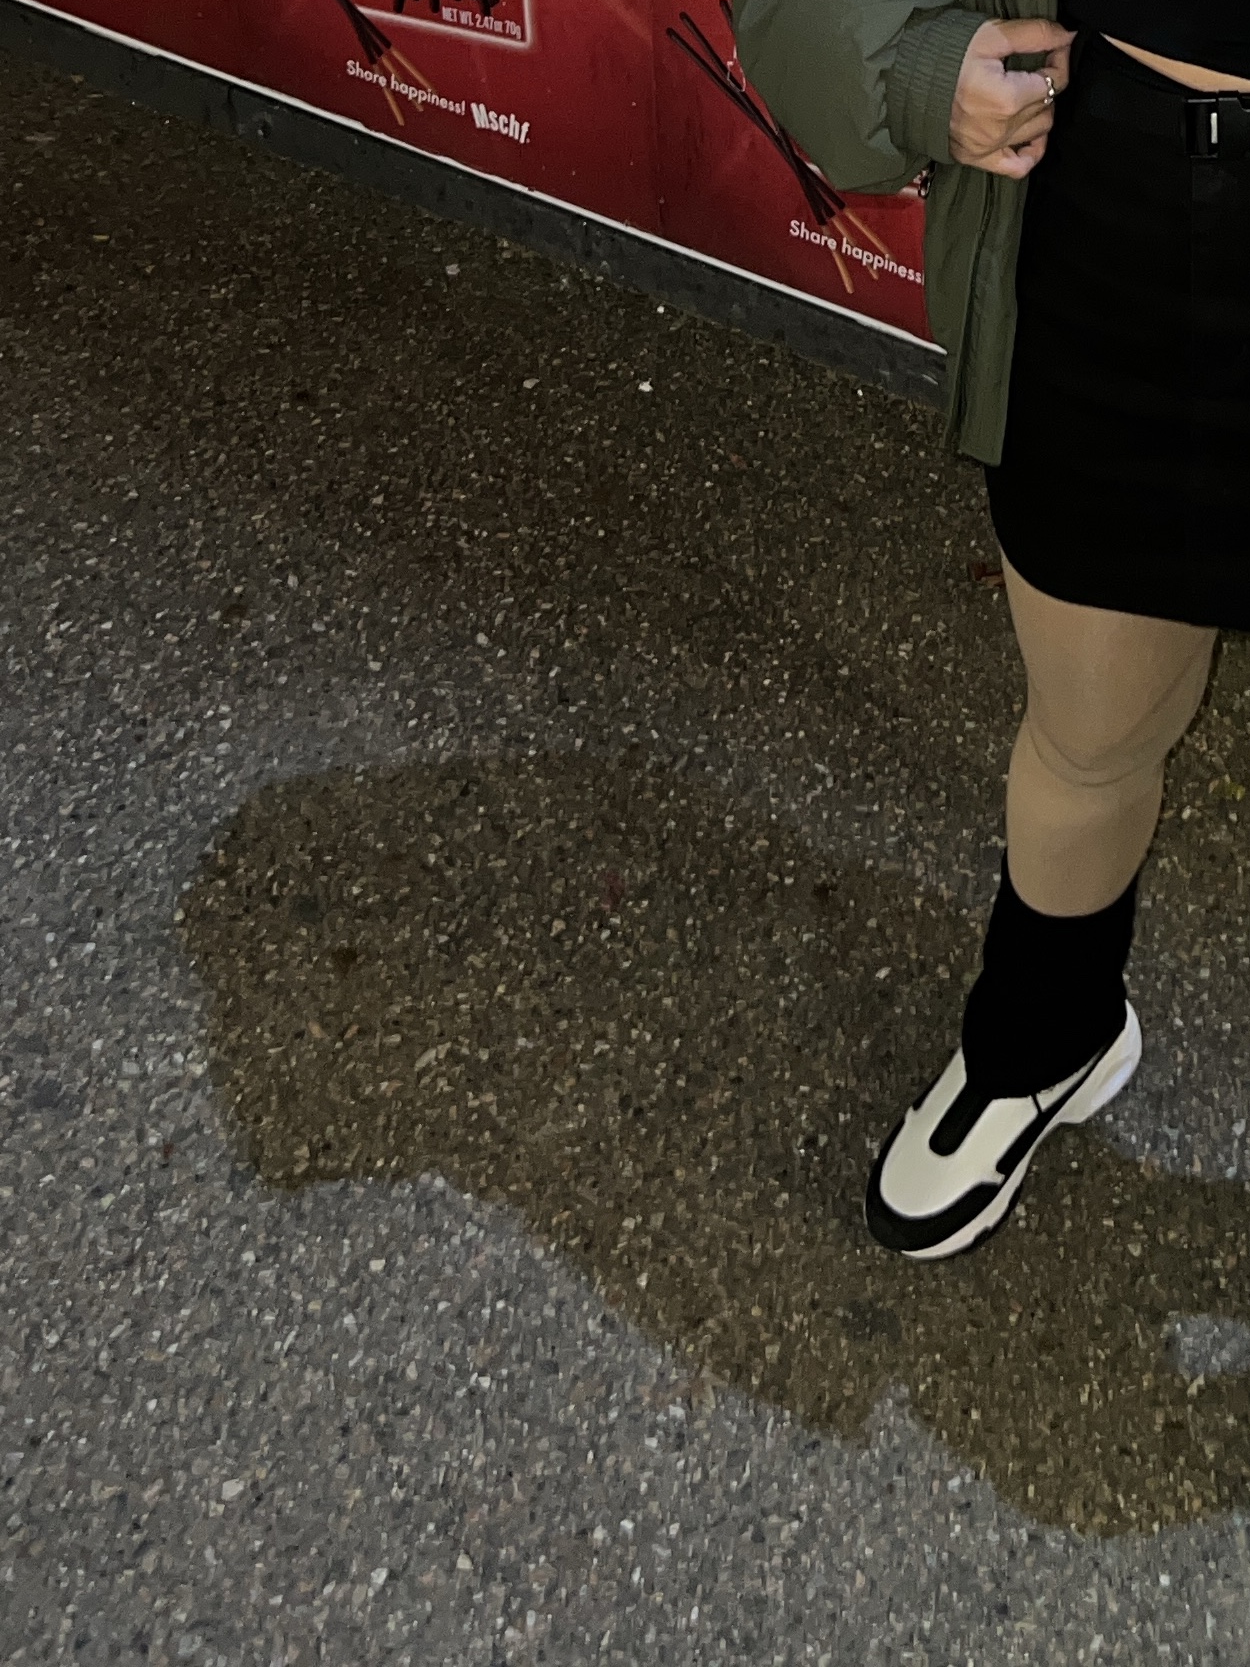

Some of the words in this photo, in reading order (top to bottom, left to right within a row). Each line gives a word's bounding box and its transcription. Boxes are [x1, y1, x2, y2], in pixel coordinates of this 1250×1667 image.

[442, 6, 458, 23] NET
[346, 59, 388, 88] Share
[390, 74, 466, 116] happiness!
[470, 101, 530, 145] Mschf
[789, 219, 837, 250] Share
